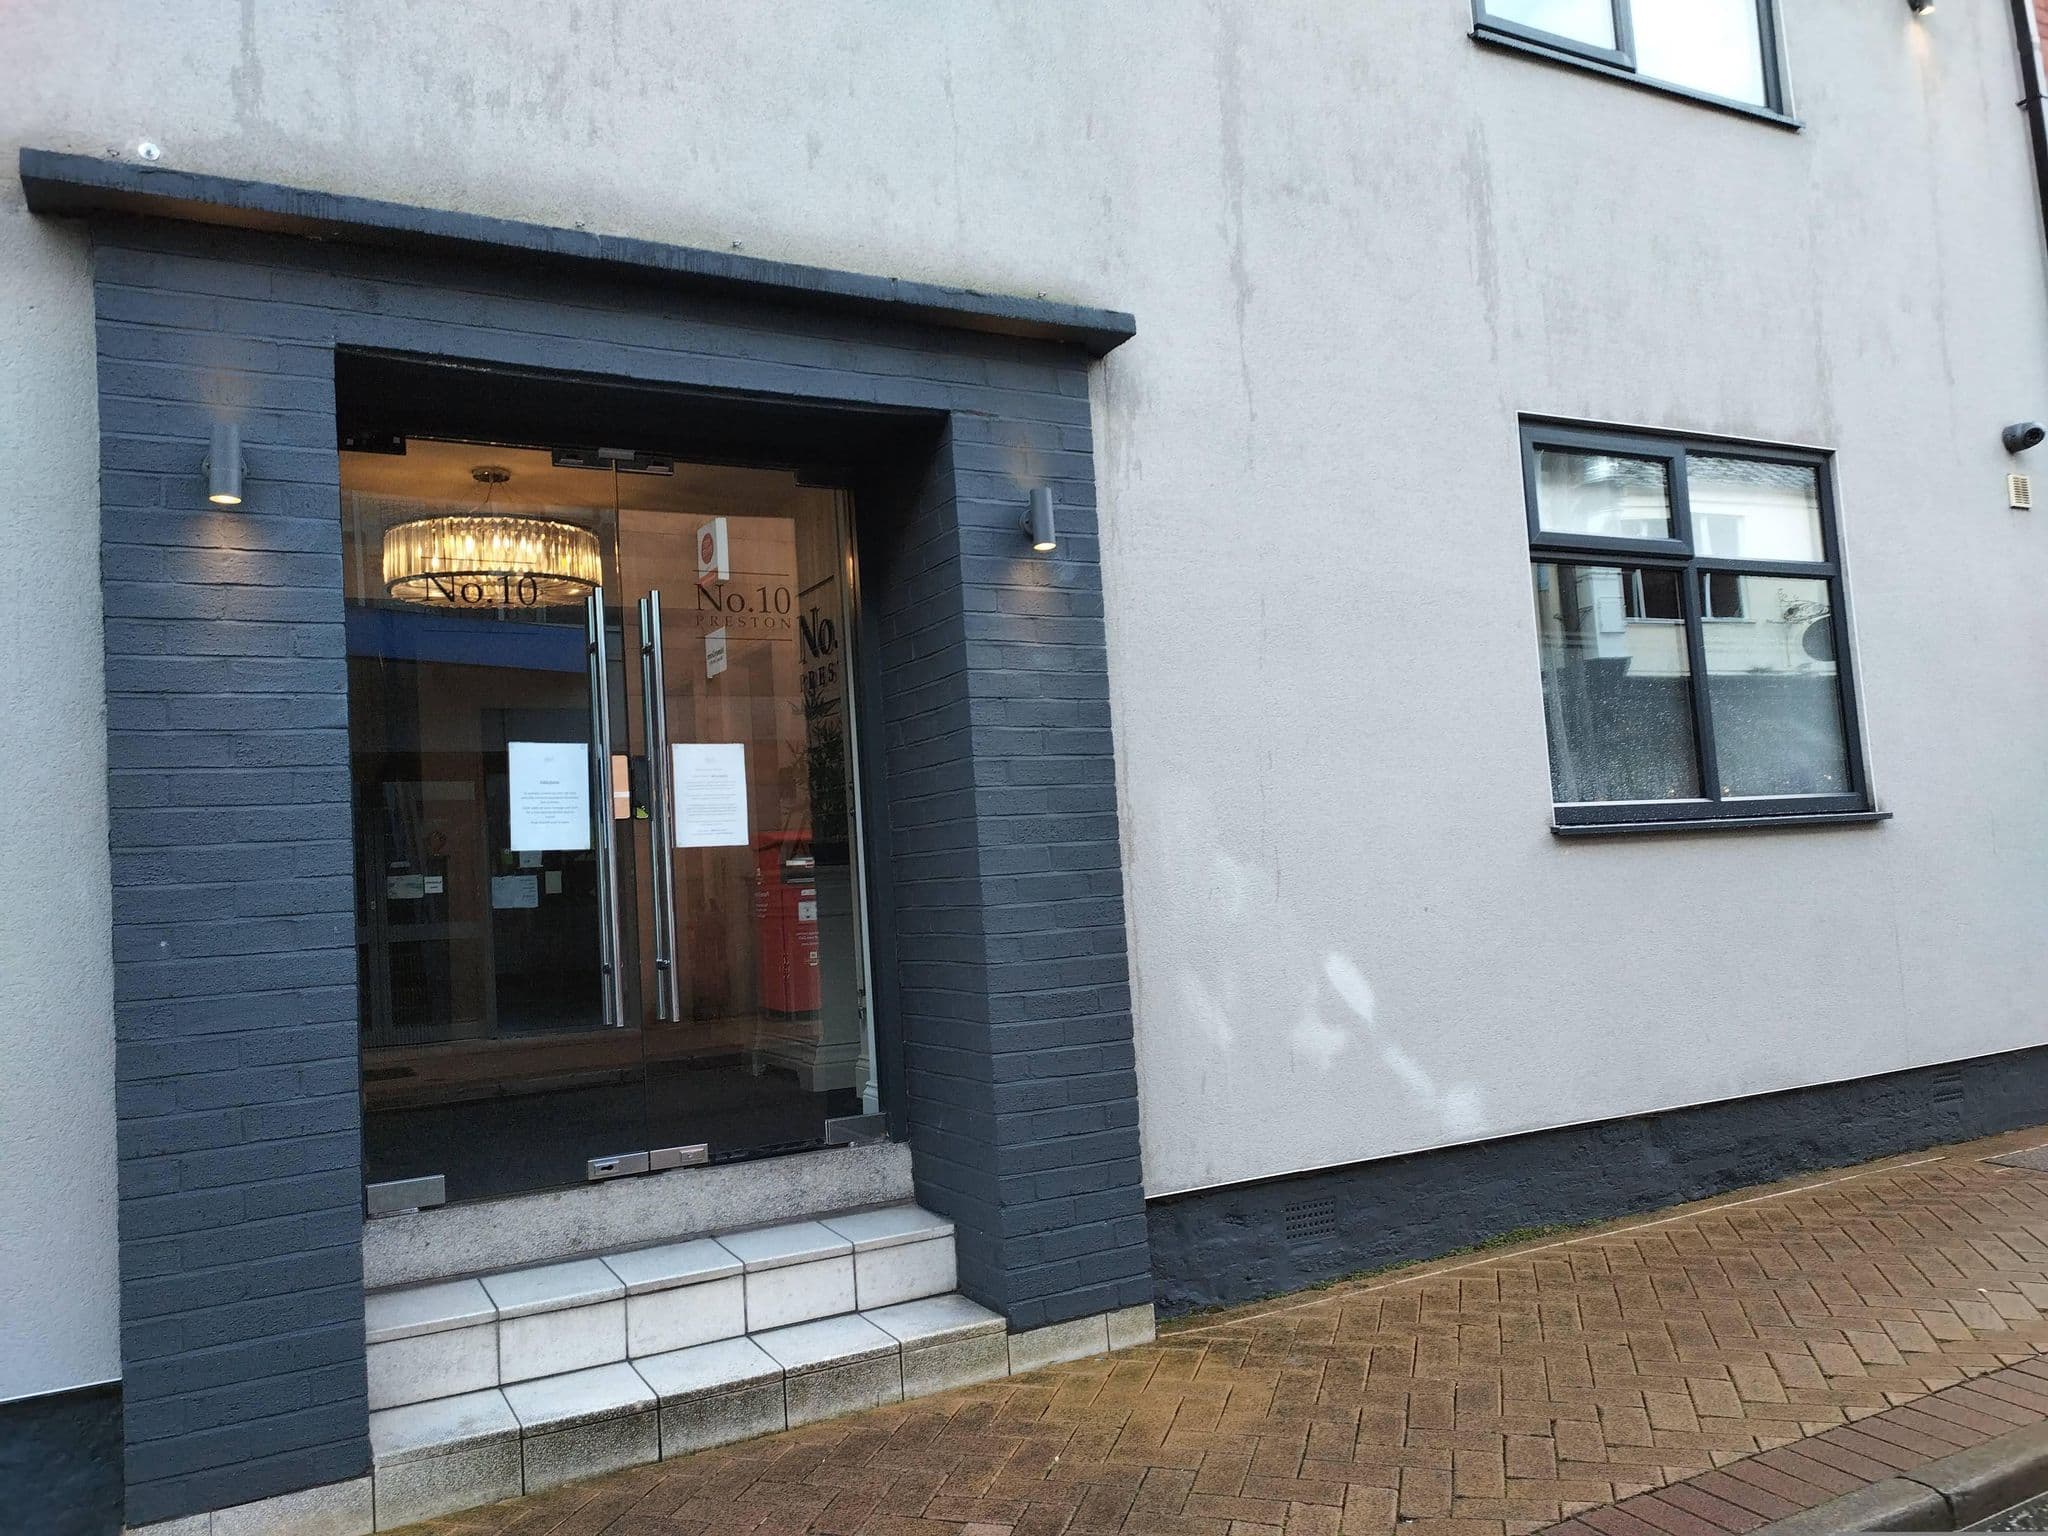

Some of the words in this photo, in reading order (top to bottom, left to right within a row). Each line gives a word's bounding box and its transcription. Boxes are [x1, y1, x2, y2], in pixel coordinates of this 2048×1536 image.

[424, 572, 538, 606] No.10
[693, 583, 791, 615] No.10
[695, 614, 792, 630] PRESTON
[800, 656, 840, 693] PRES
